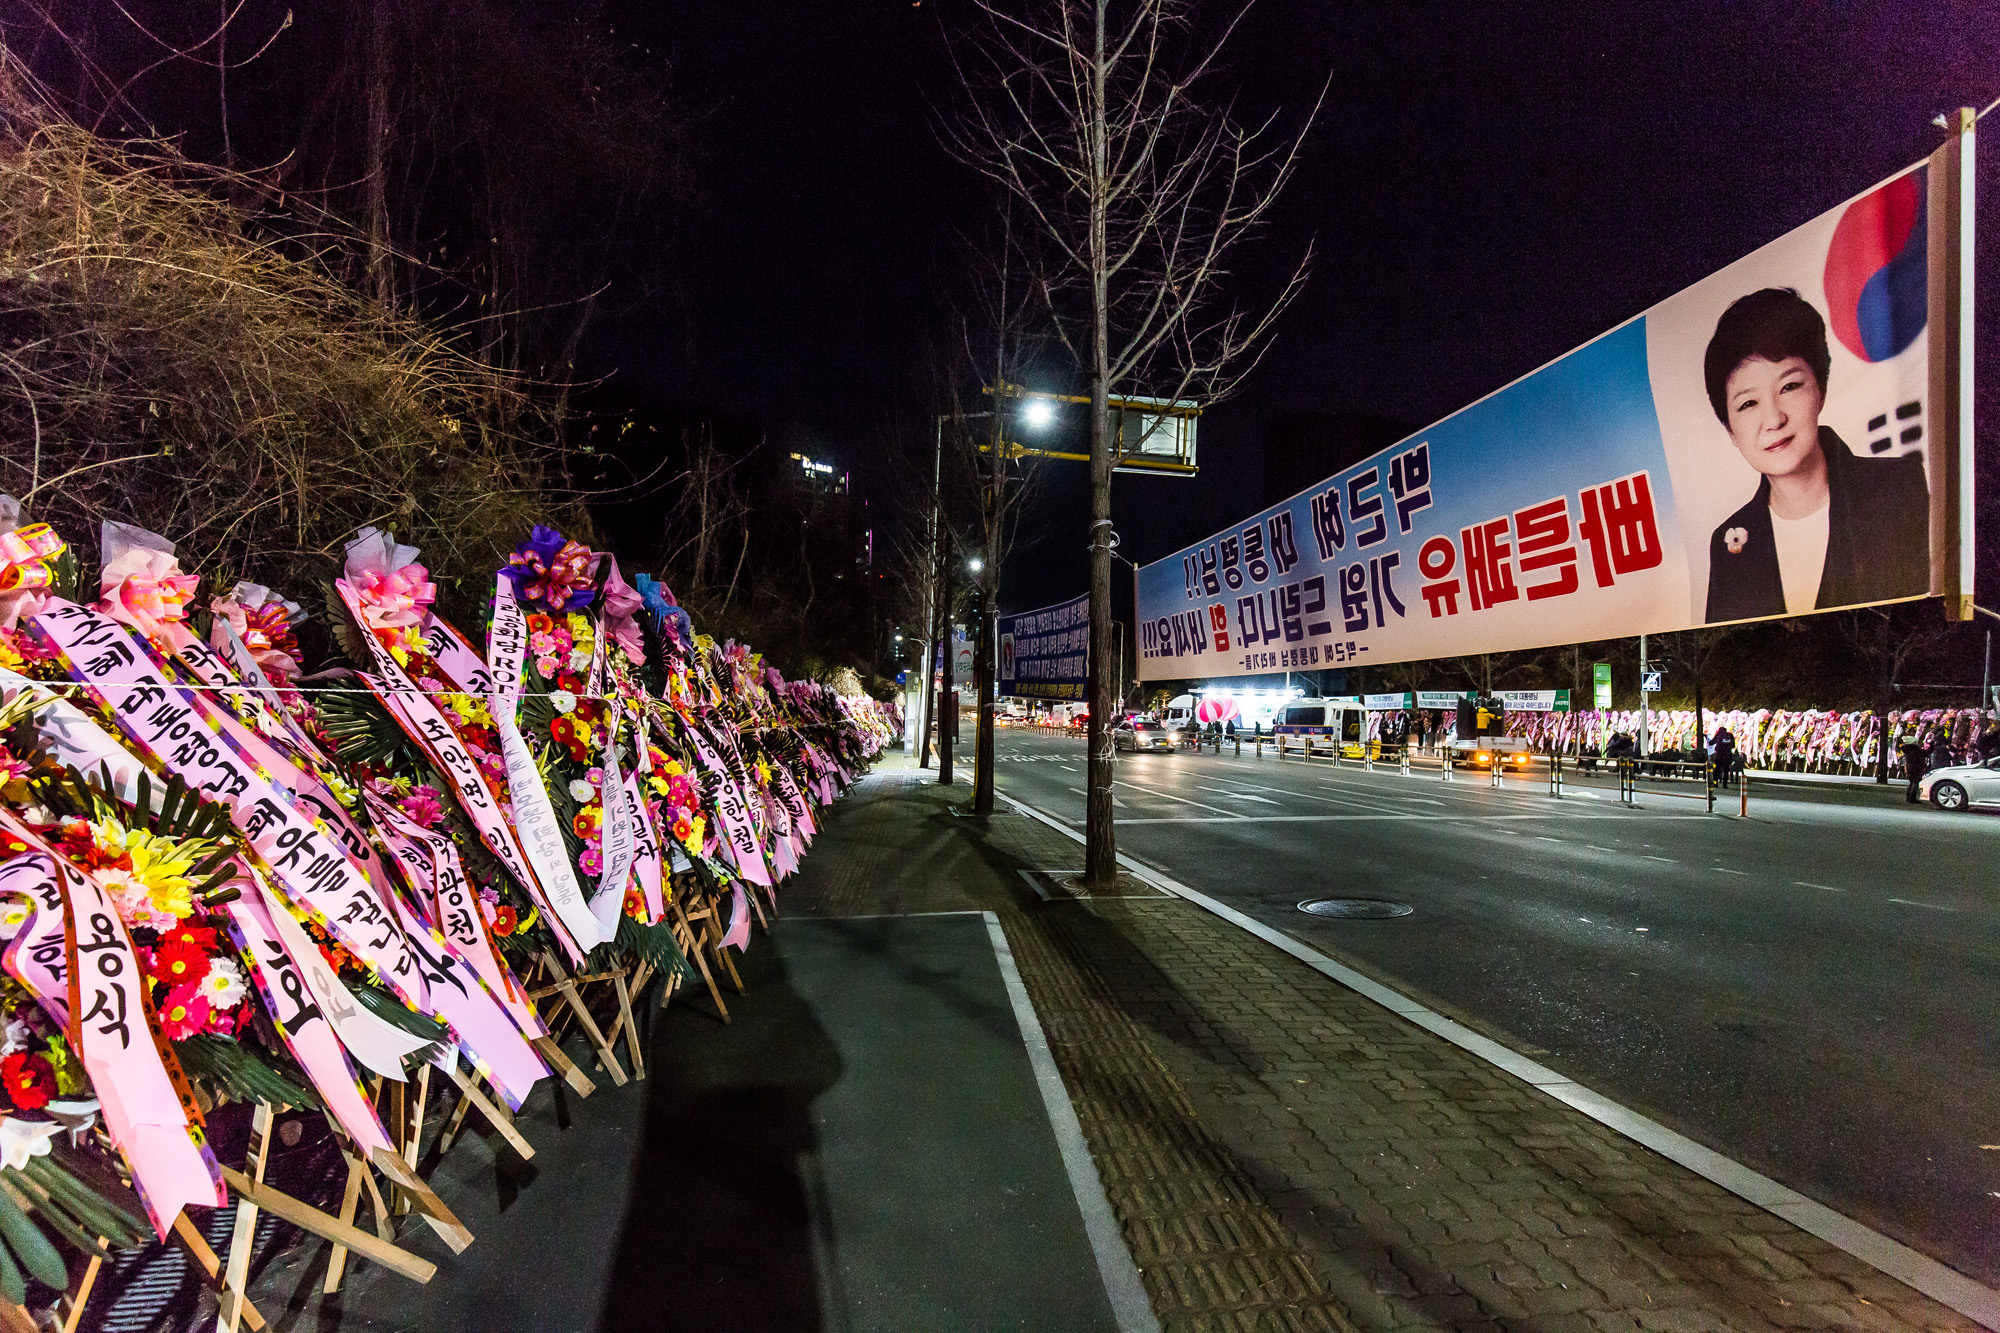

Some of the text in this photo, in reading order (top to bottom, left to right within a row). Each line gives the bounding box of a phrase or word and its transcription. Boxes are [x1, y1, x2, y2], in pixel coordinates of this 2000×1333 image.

[42, 605, 136, 677] 박근혜
[117, 675, 250, 797] 대통령님
[245, 797, 350, 893] 쾌유를
[492, 657, 518, 706] ROT
